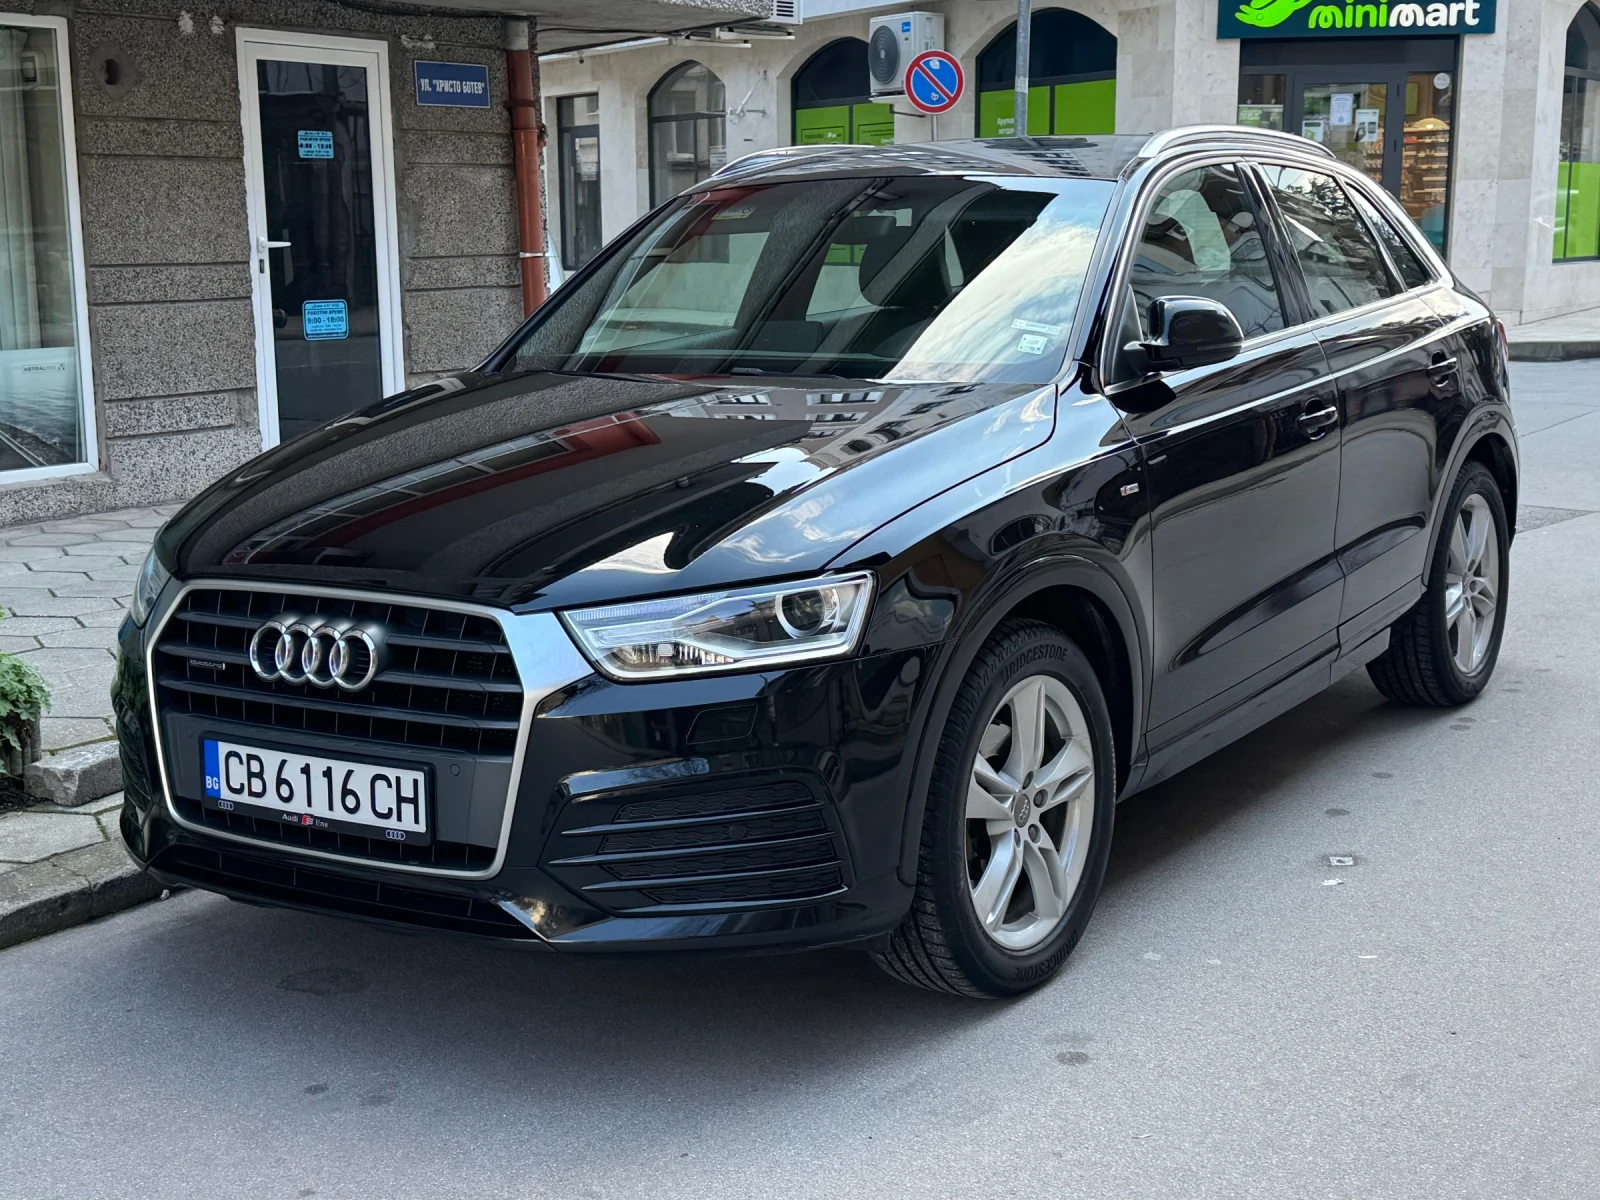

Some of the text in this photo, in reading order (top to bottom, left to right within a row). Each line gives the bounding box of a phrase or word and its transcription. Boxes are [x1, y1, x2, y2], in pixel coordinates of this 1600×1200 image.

[1308, 0, 1480, 28] minimart
[420, 78, 485, 94] УЛ. "ХРИСТО БОТЕВ"
[1001, 644, 1068, 687] BRIDGESTONE
[205, 776, 220, 790] BG
[281, 813, 299, 823] Audi
[315, 819, 329, 829] line
